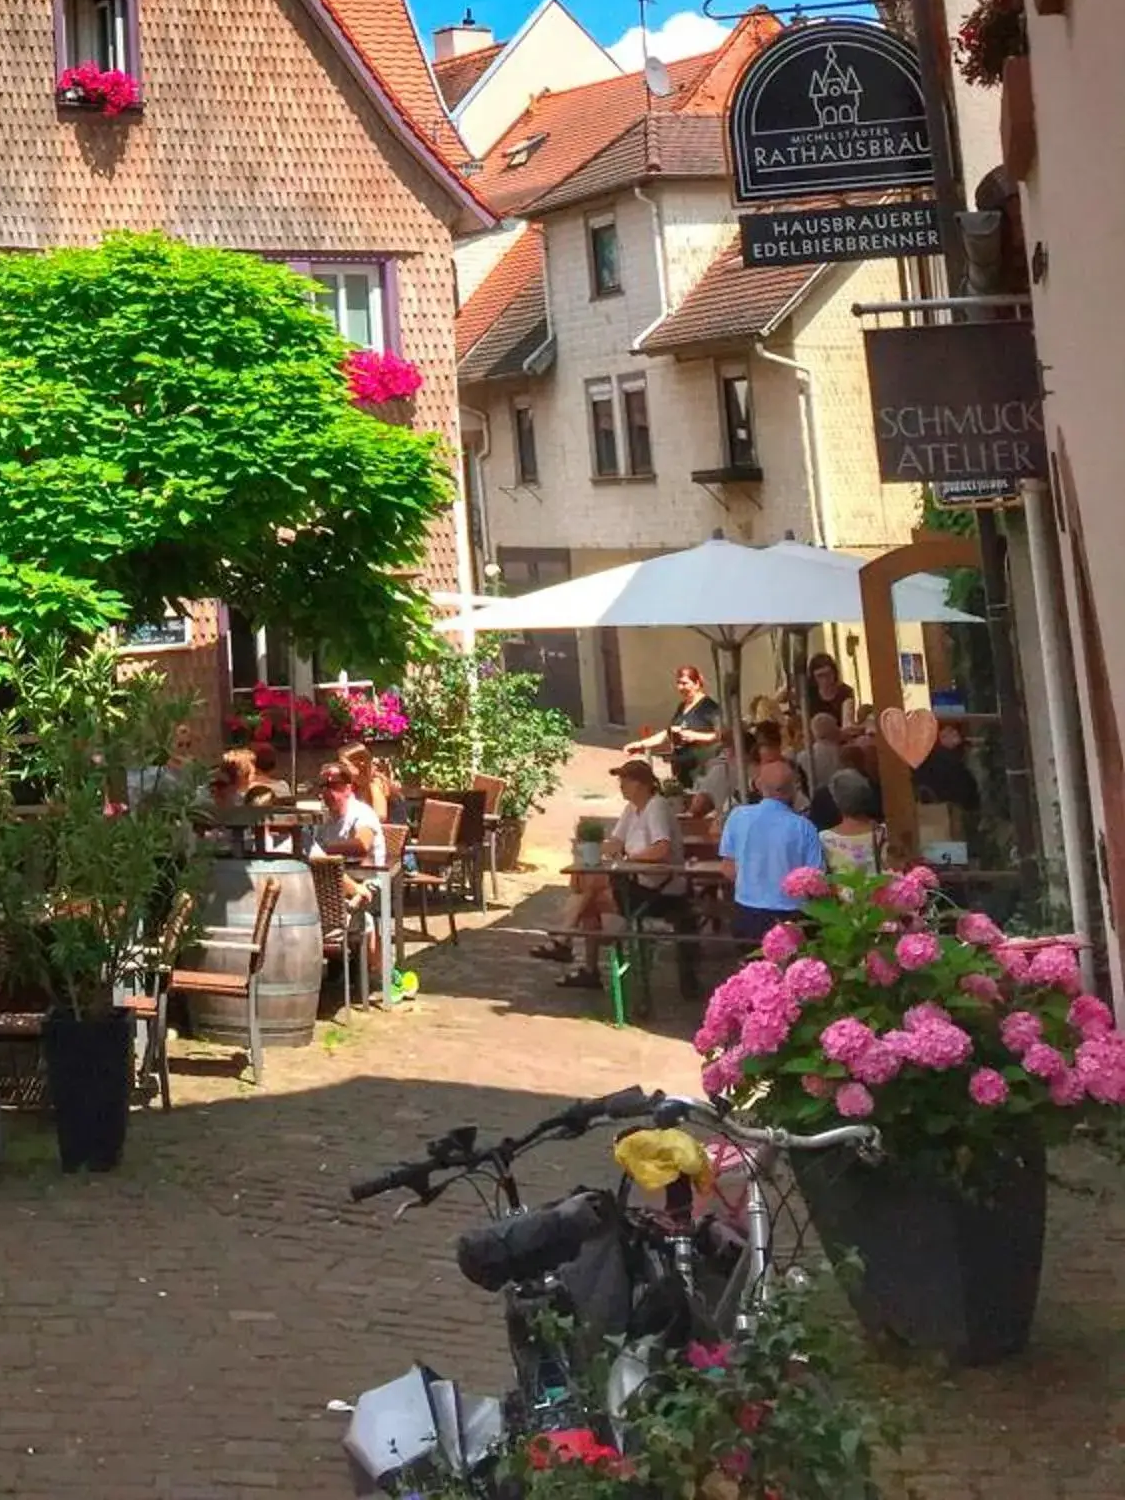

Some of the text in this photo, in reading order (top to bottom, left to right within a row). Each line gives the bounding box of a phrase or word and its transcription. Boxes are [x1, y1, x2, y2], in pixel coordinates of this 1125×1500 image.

[754, 131, 932, 167] RATHAUSBRÄU
[773, 210, 933, 237] HAUSBRAUEREI
[752, 230, 940, 258] EDELBIERBRENNER
[879, 401, 1044, 438] SCHMUCK
[896, 440, 1036, 476] ATELIER
